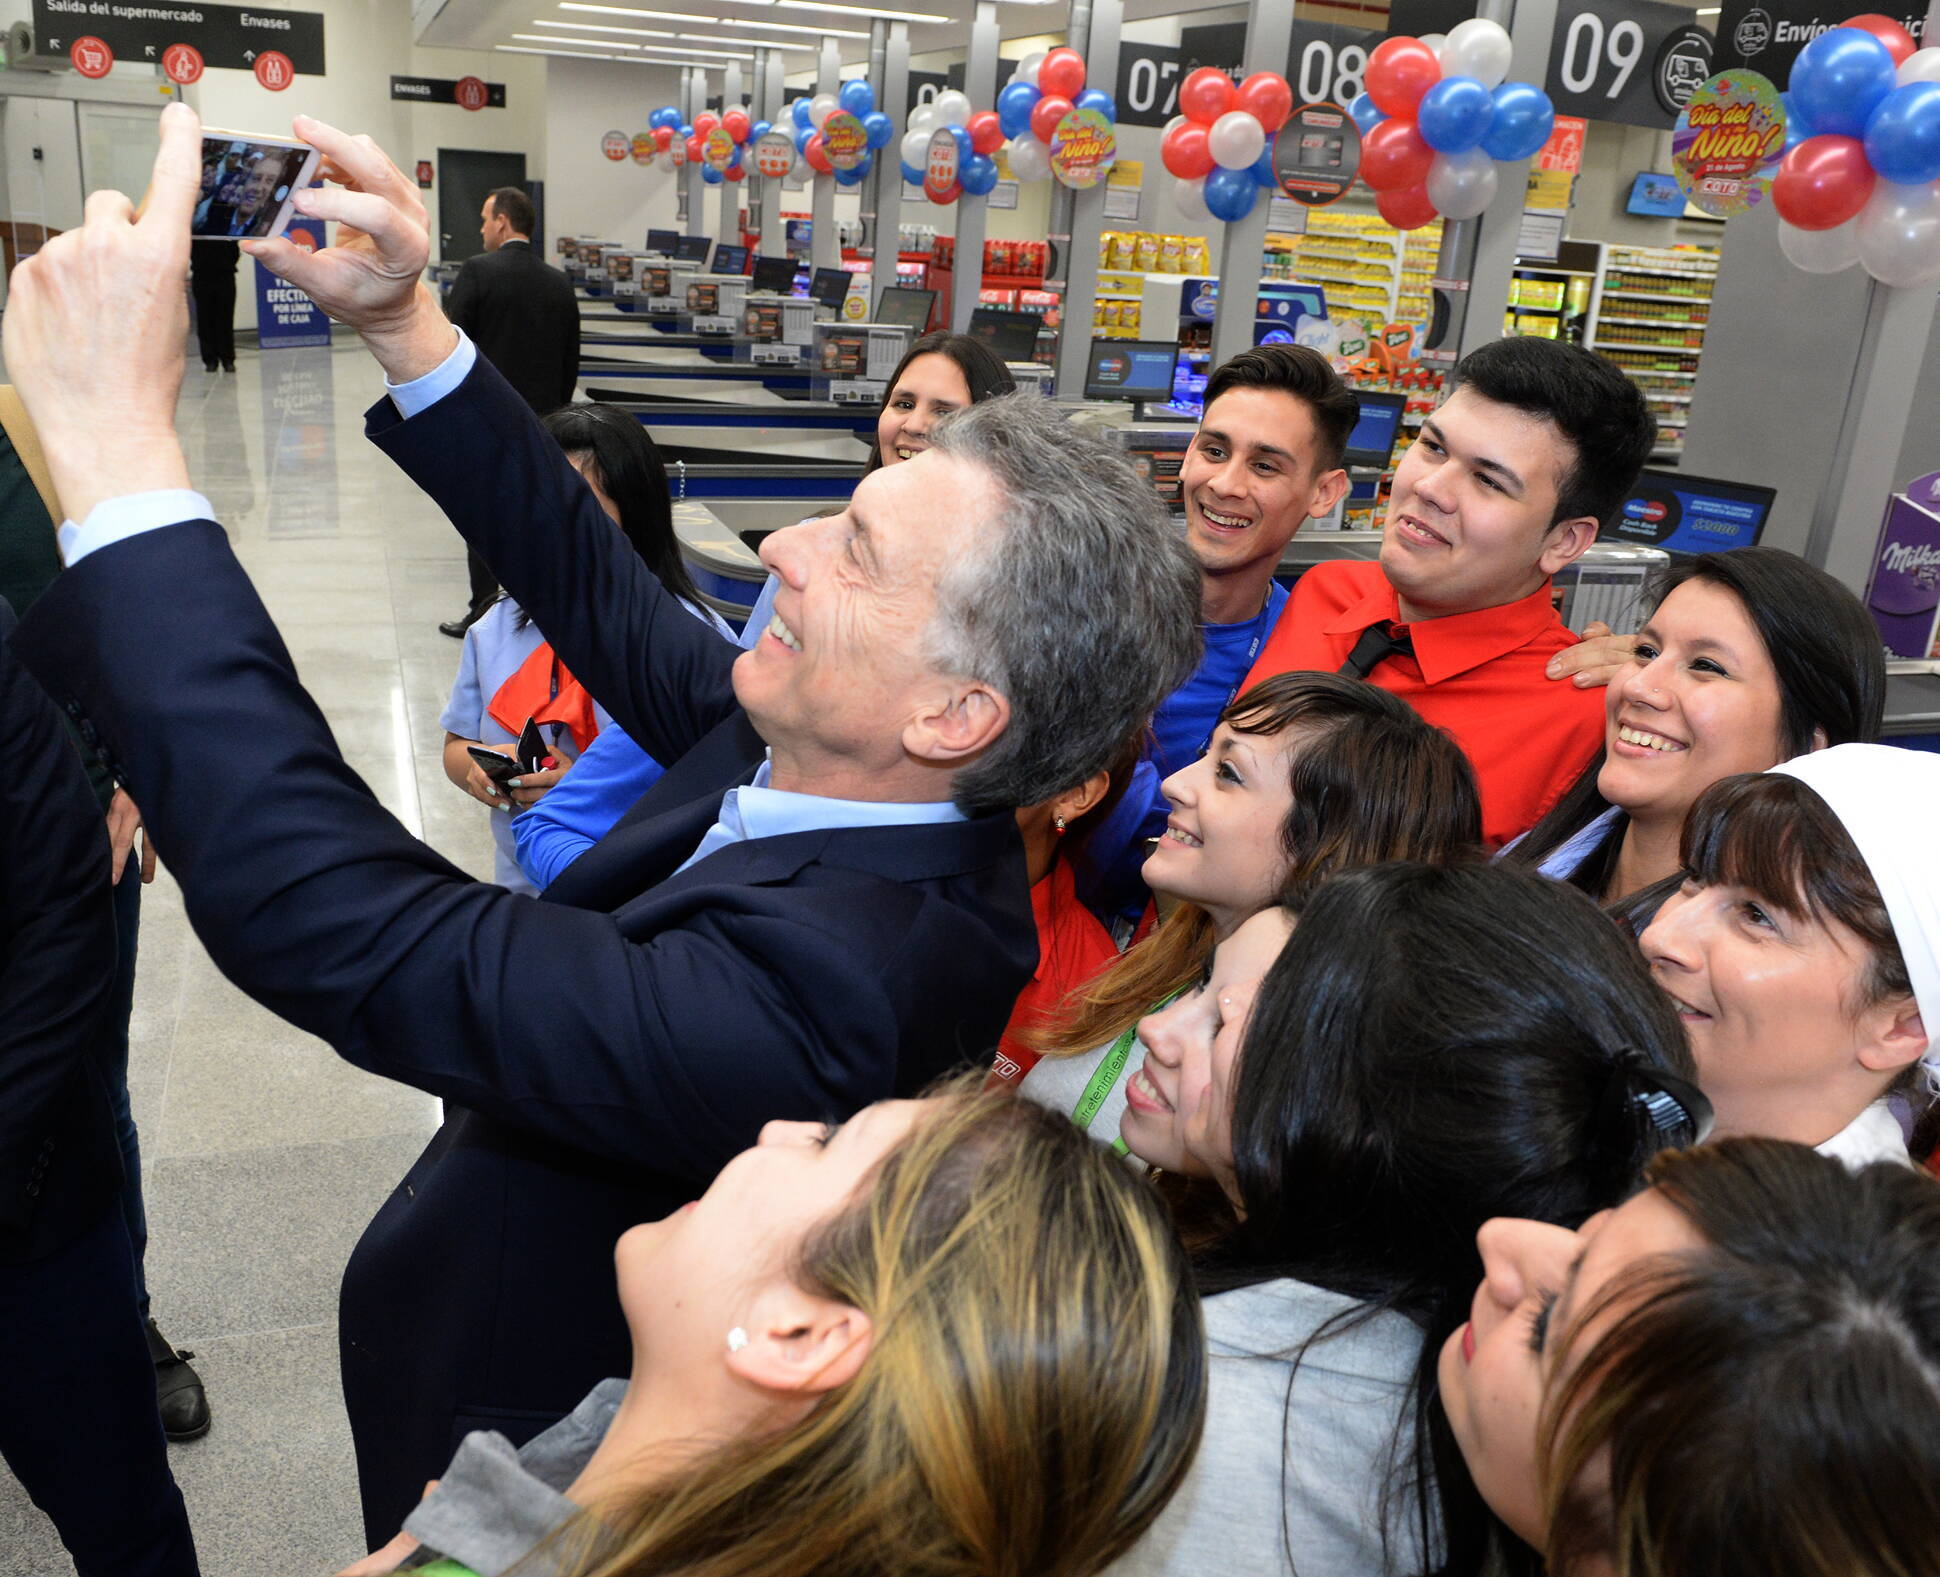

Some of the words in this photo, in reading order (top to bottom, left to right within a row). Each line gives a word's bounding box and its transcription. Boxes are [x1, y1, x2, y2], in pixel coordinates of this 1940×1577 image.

[47, 0, 88, 14] Salida
[90, 2, 109, 16] del
[112, 5, 204, 24] supermercado
[240, 13, 291, 30] Envases
[1561, 12, 1644, 99] 09
[1299, 40, 1368, 108] 08
[394, 83, 431, 95] ENVASES
[1689, 103, 1721, 127] Día
[1721, 103, 1754, 126] del
[1687, 124, 1781, 161] Niño!
[1703, 179, 1740, 194] COTO
[1627, 503, 1664, 516] Maestro
[1618, 524, 1658, 536] Disponible
[1622, 518, 1641, 527] Cash
[1640, 521, 1658, 530] Back
[992, 1052, 1021, 1080] TO
